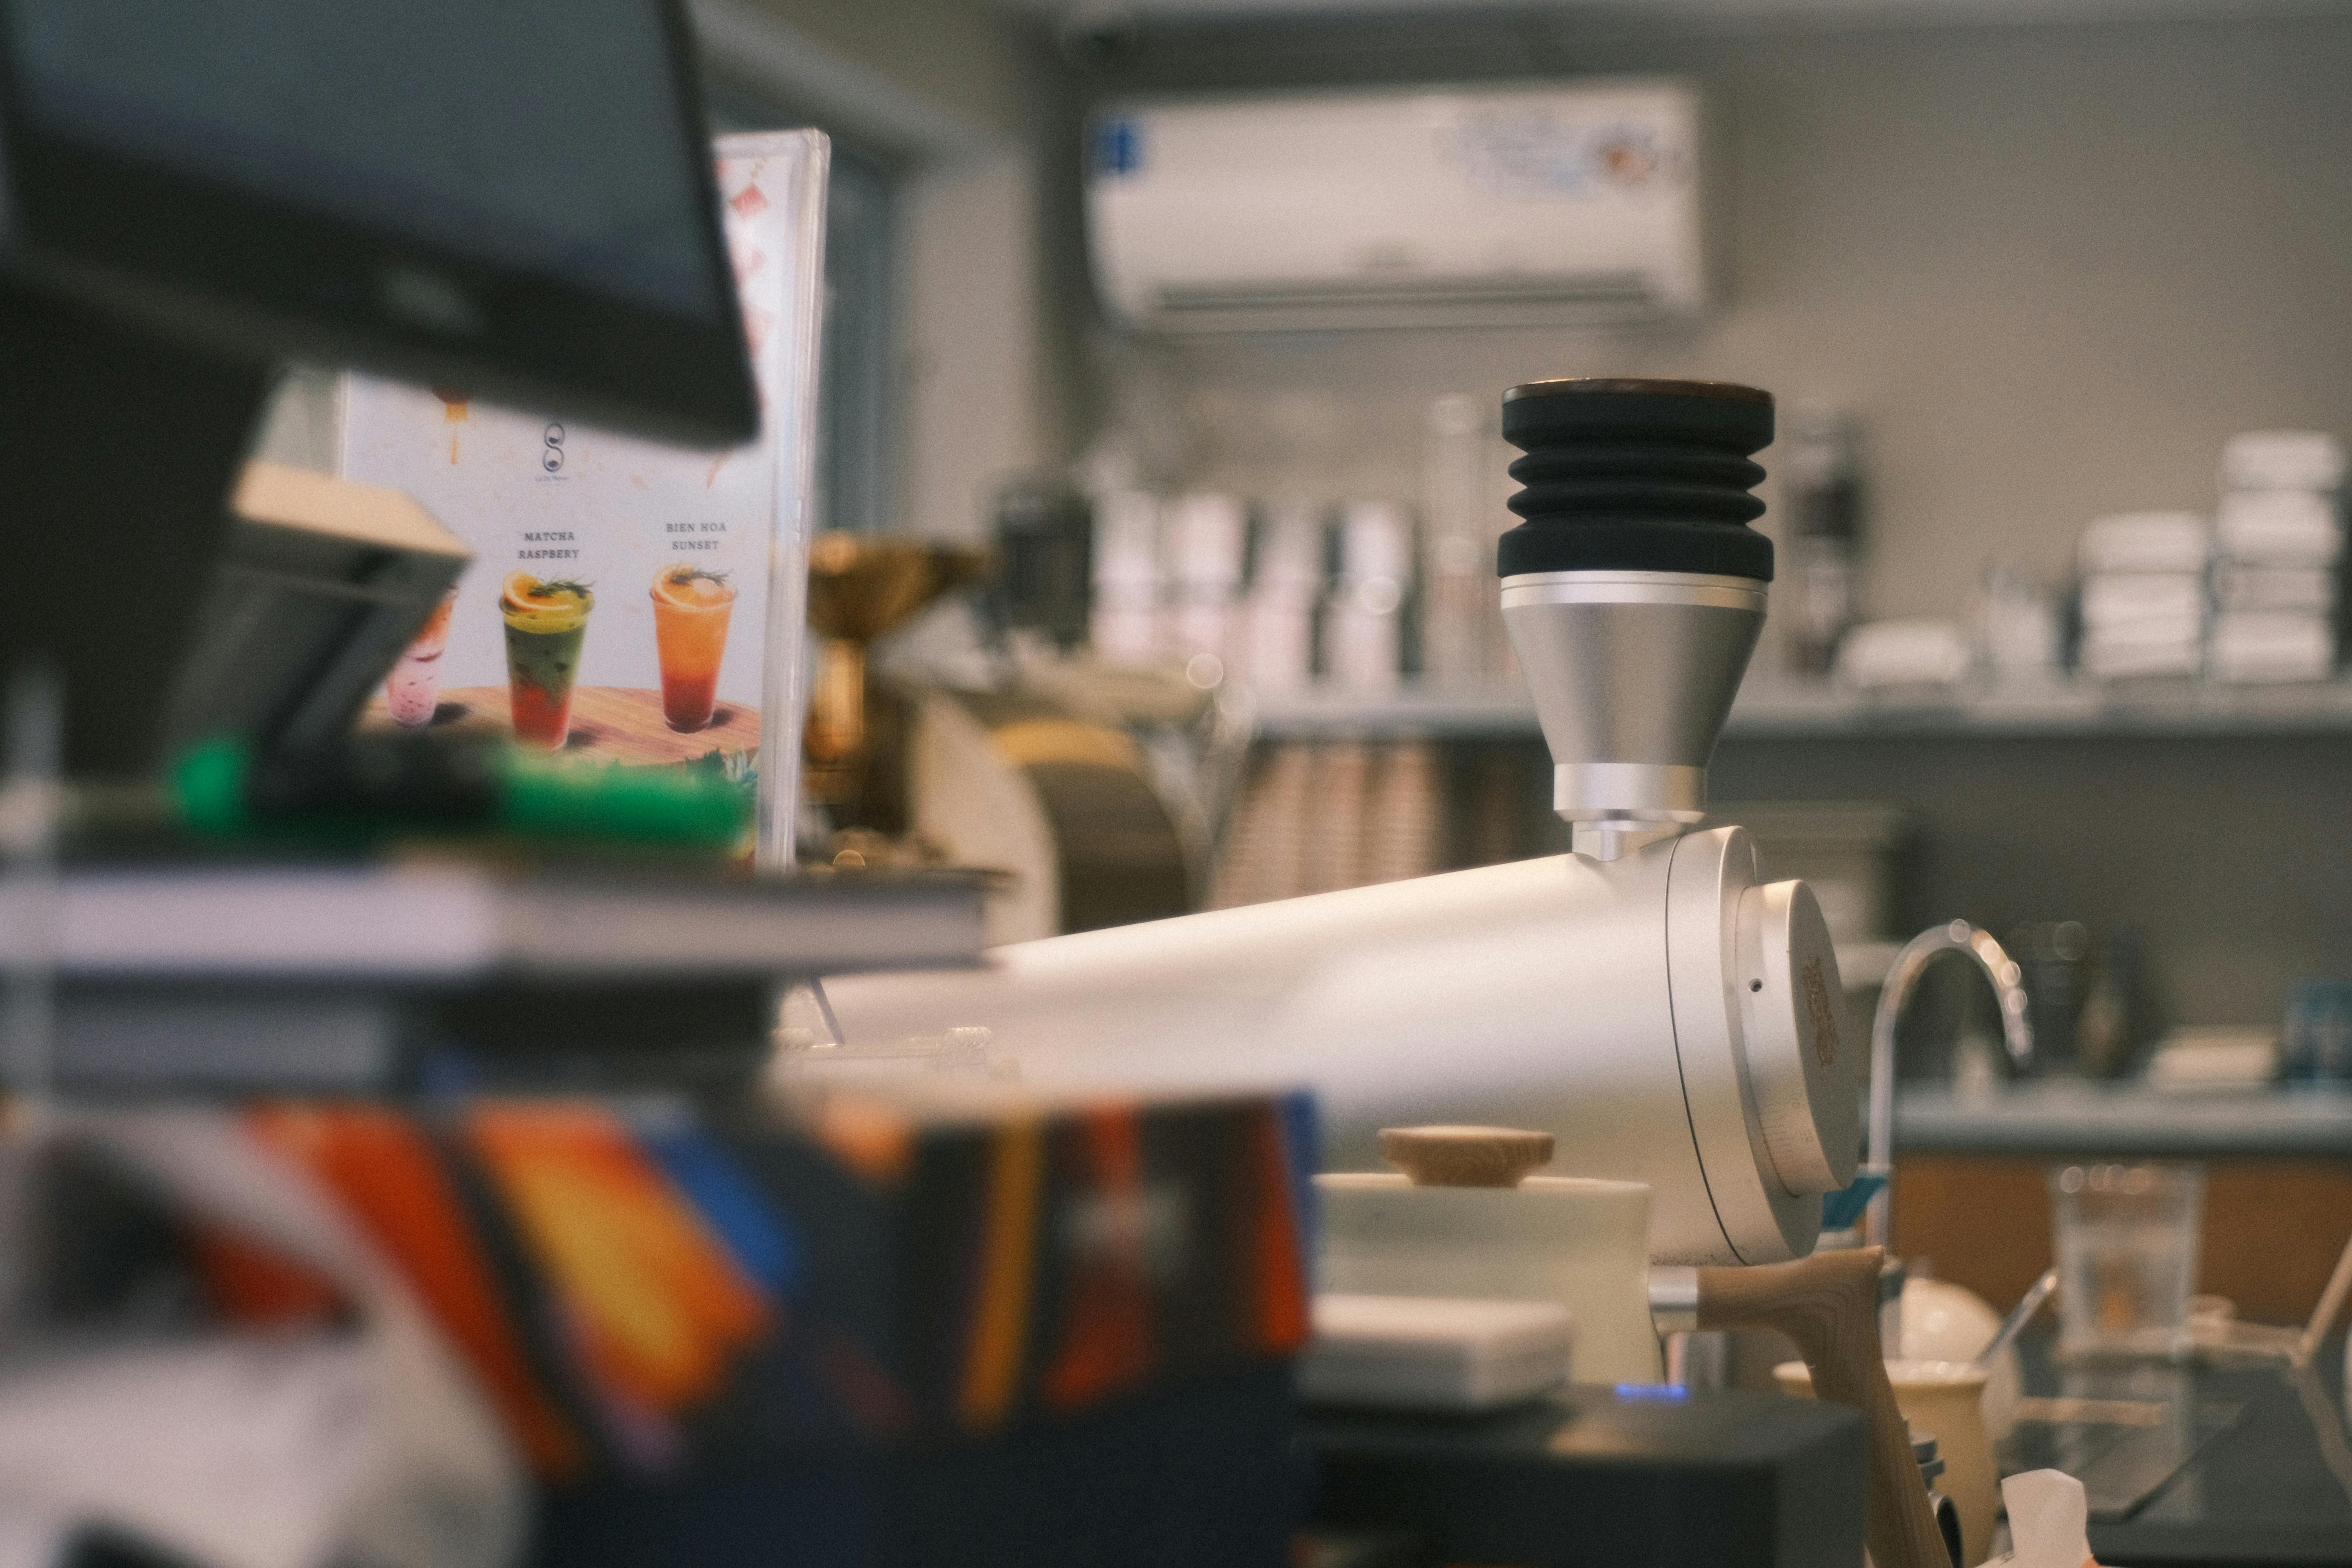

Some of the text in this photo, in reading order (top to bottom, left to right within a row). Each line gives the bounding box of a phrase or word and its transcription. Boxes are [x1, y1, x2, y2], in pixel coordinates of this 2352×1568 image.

[667, 523, 726, 532] BIEN HOA
[525, 532, 574, 541] MATCHA
[672, 541, 719, 550] SUNSET
[519, 550, 579, 559] RASPBERY
